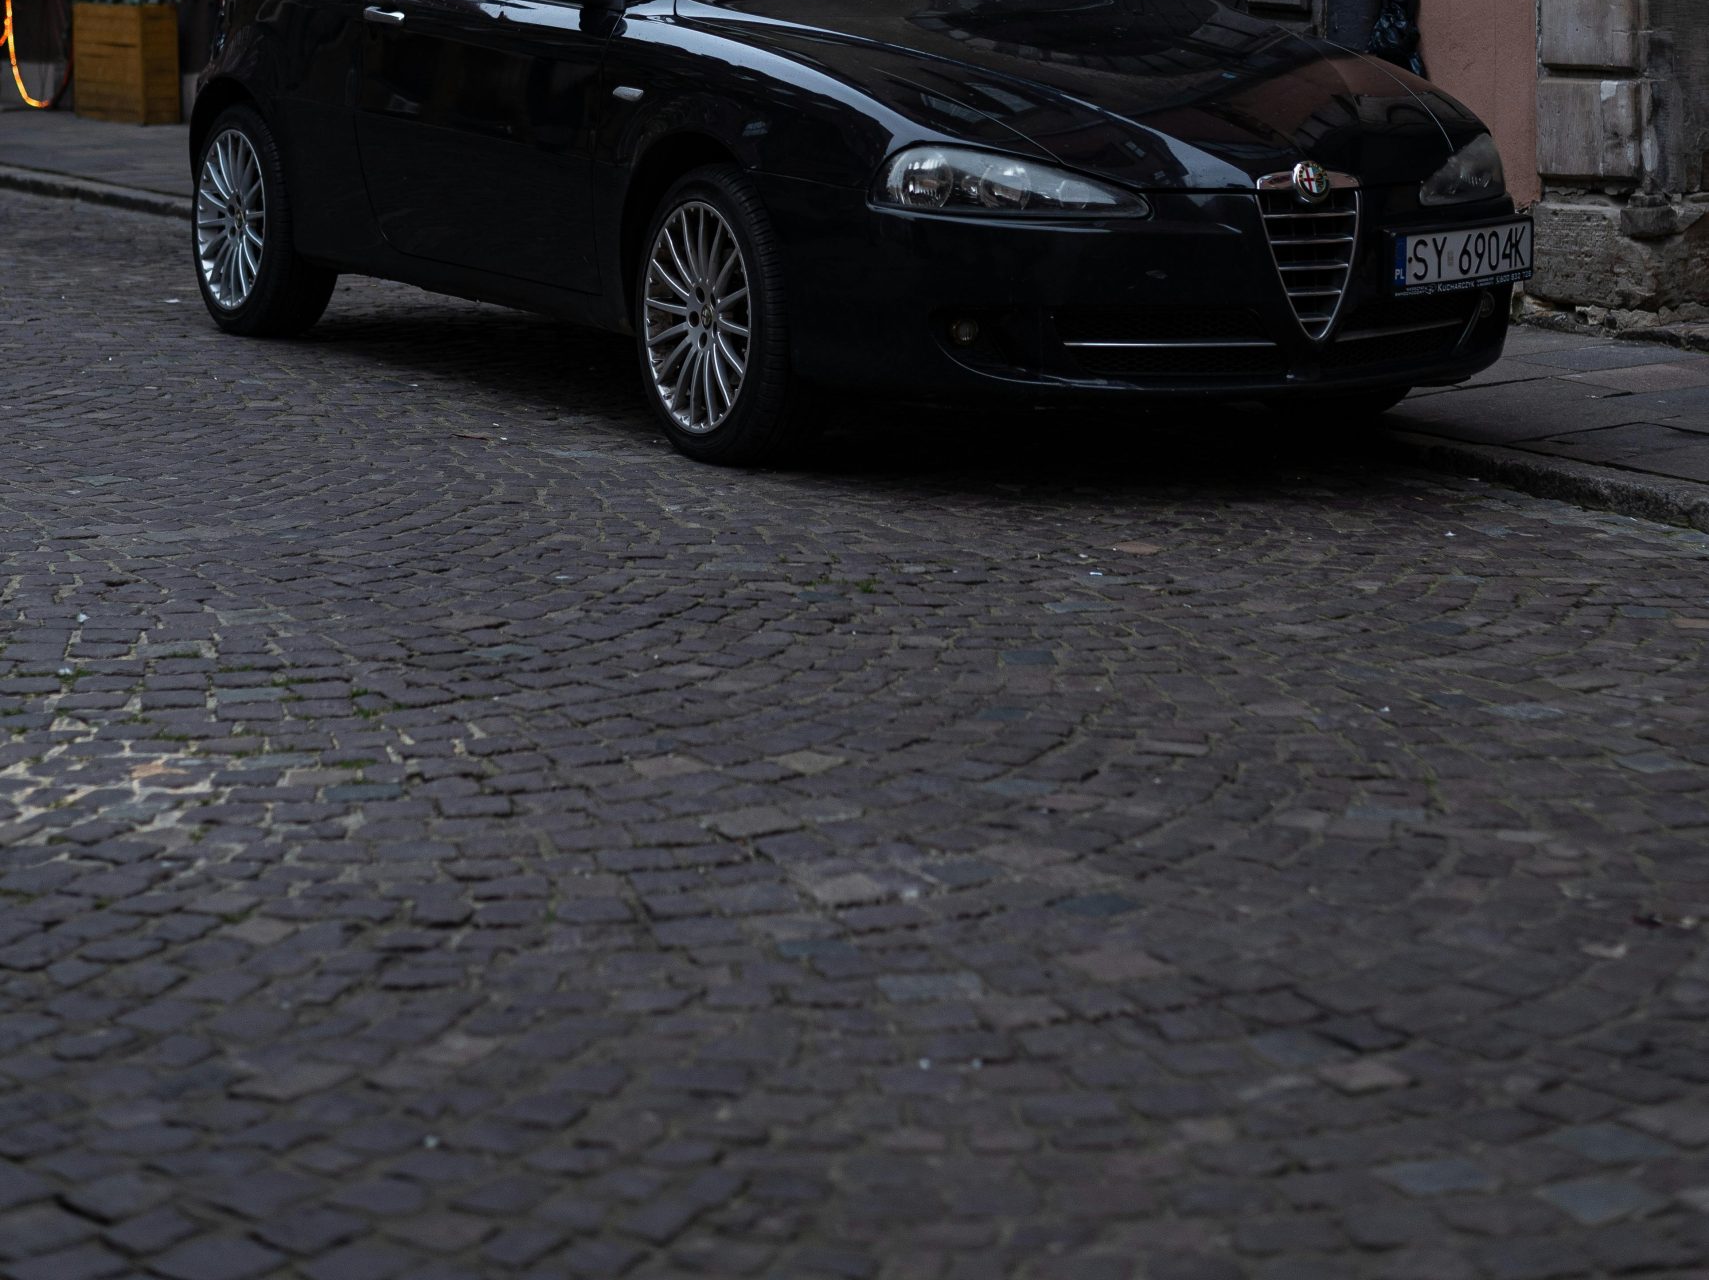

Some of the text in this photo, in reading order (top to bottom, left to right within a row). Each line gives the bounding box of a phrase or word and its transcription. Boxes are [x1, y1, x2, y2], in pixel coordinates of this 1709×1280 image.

[1413, 226, 1526, 281] SY 6904K
[1394, 268, 1405, 280] PL
